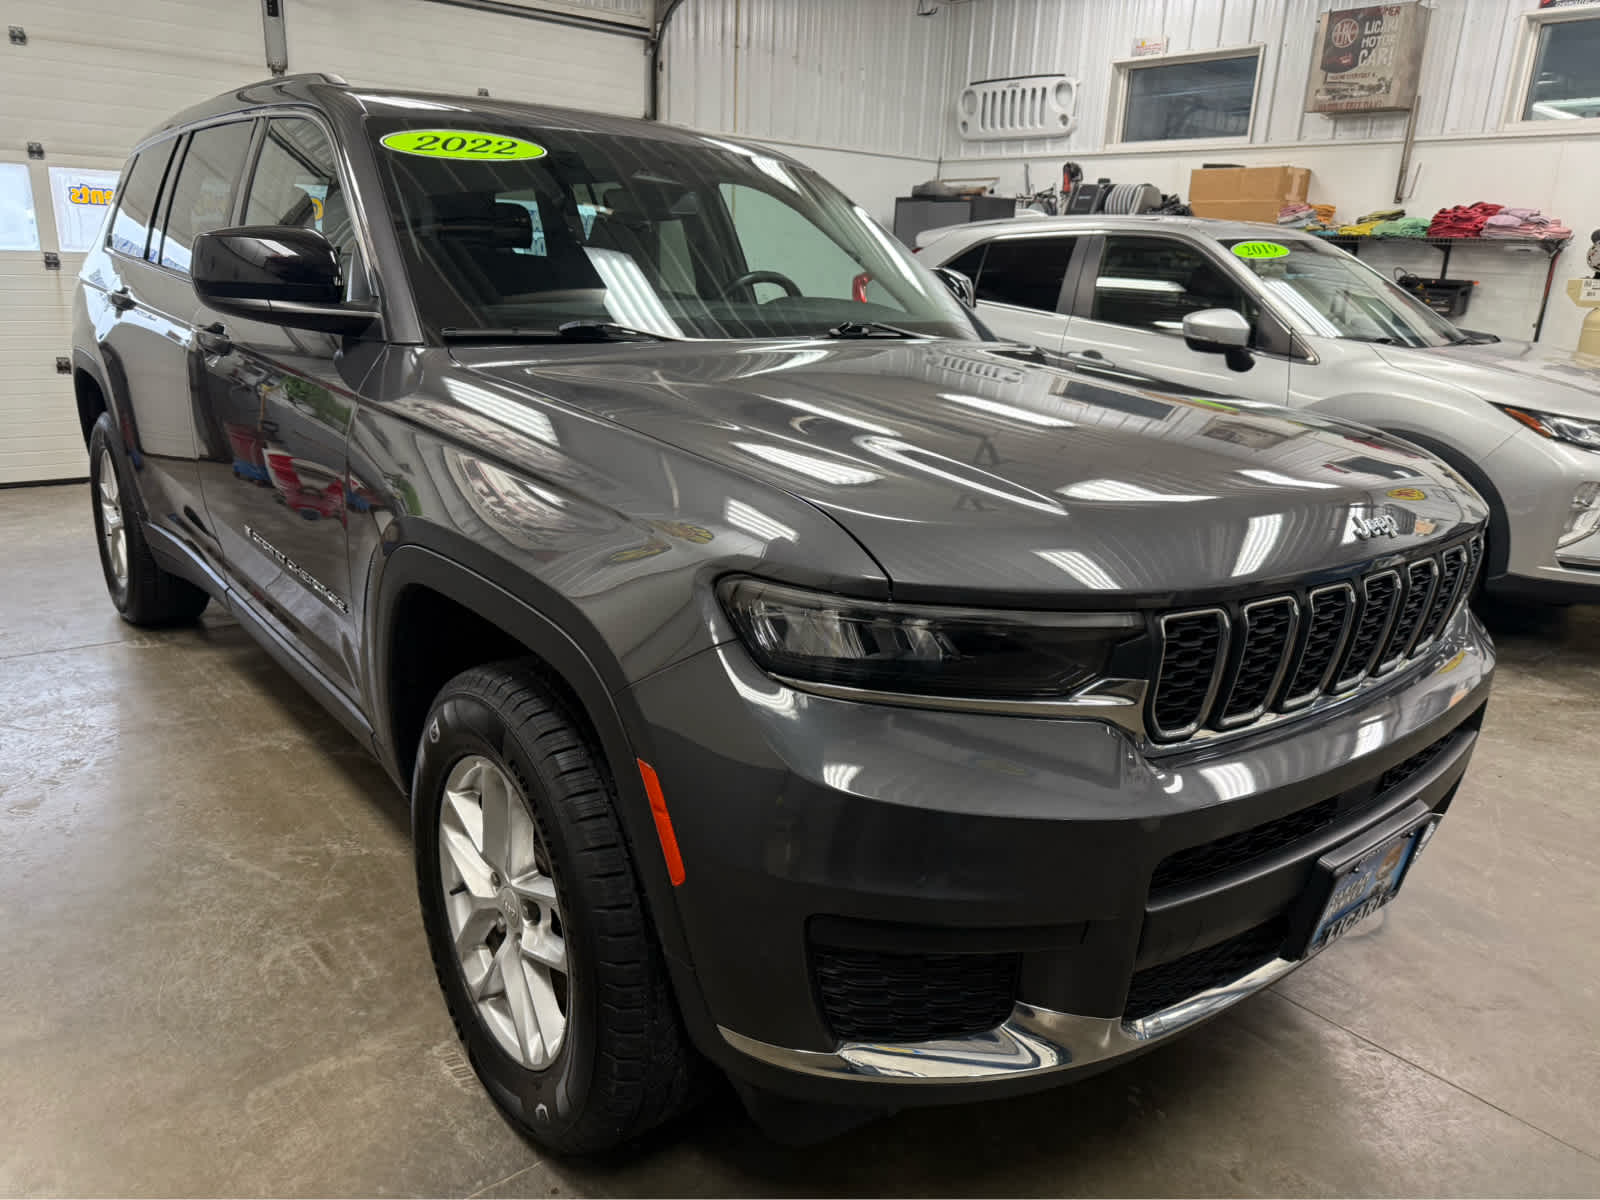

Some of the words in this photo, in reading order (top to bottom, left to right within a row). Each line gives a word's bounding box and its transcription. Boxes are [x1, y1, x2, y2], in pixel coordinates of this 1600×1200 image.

[413, 135, 518, 155] 2022
[1243, 243, 1279, 256] 2019
[1352, 514, 1400, 540] Jeep
